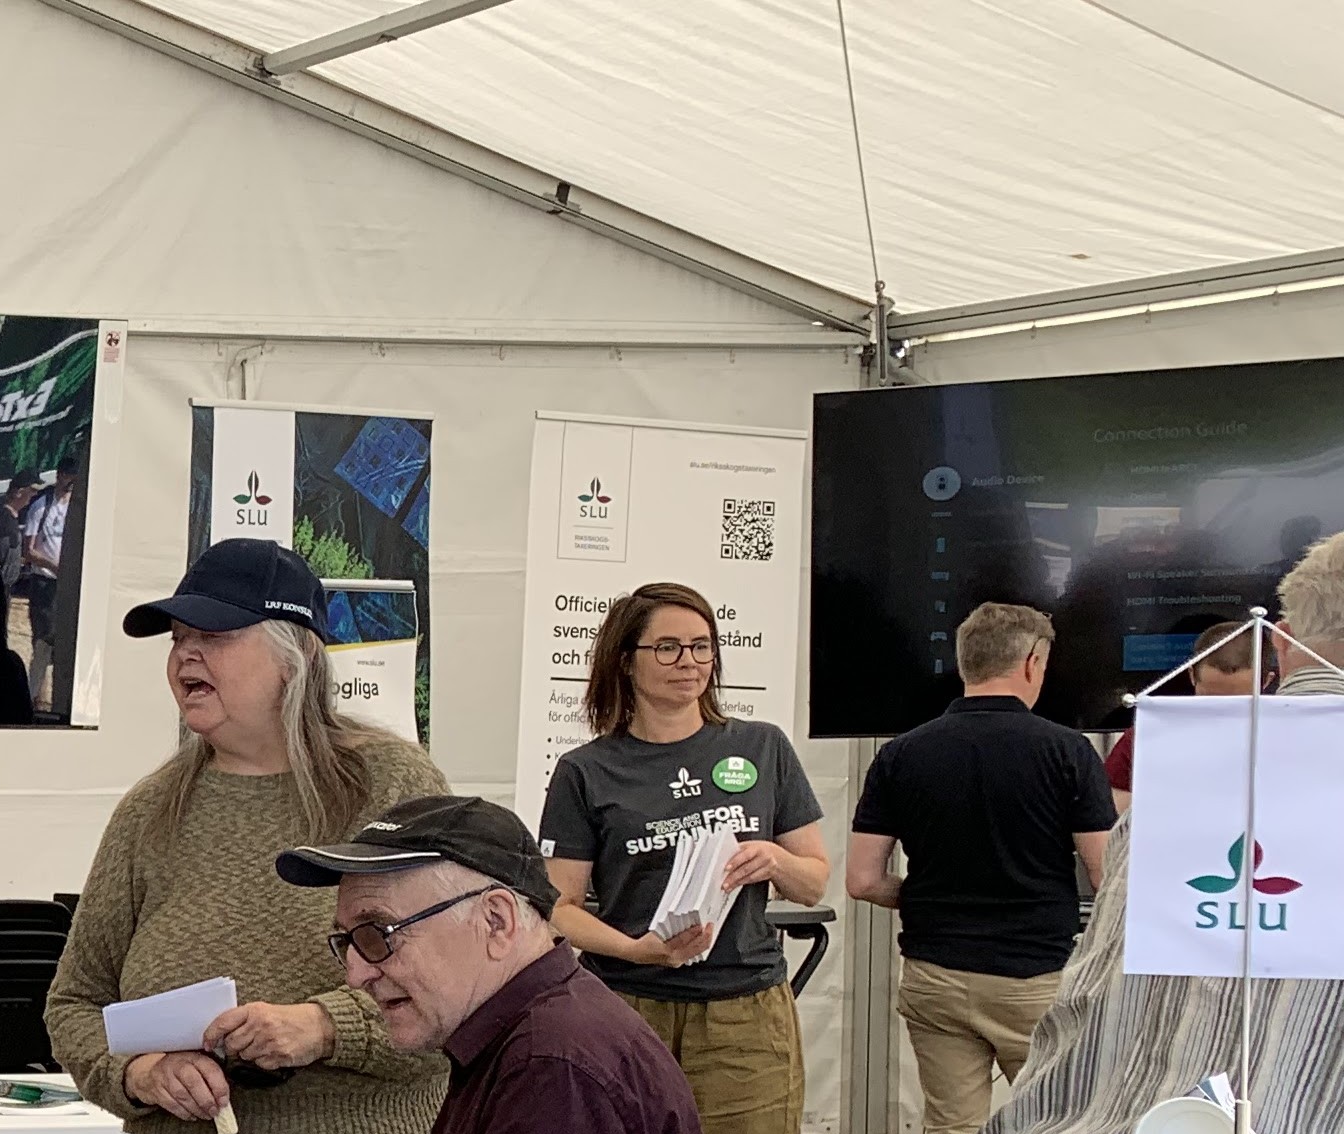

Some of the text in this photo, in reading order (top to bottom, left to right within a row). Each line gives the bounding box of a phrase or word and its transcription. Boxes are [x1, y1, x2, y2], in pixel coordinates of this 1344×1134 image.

[1094, 421, 1248, 443] Connection Guide
[972, 474, 1045, 487] Audio Device
[236, 508, 268, 526] SLU
[580, 505, 608, 519] SLU
[552, 649, 580, 665] och
[549, 689, 579, 708] Årliga
[548, 710, 562, 723] för
[673, 785, 702, 799] SLU
[702, 805, 745, 825] FOR
[1195, 901, 1288, 931] SLU
